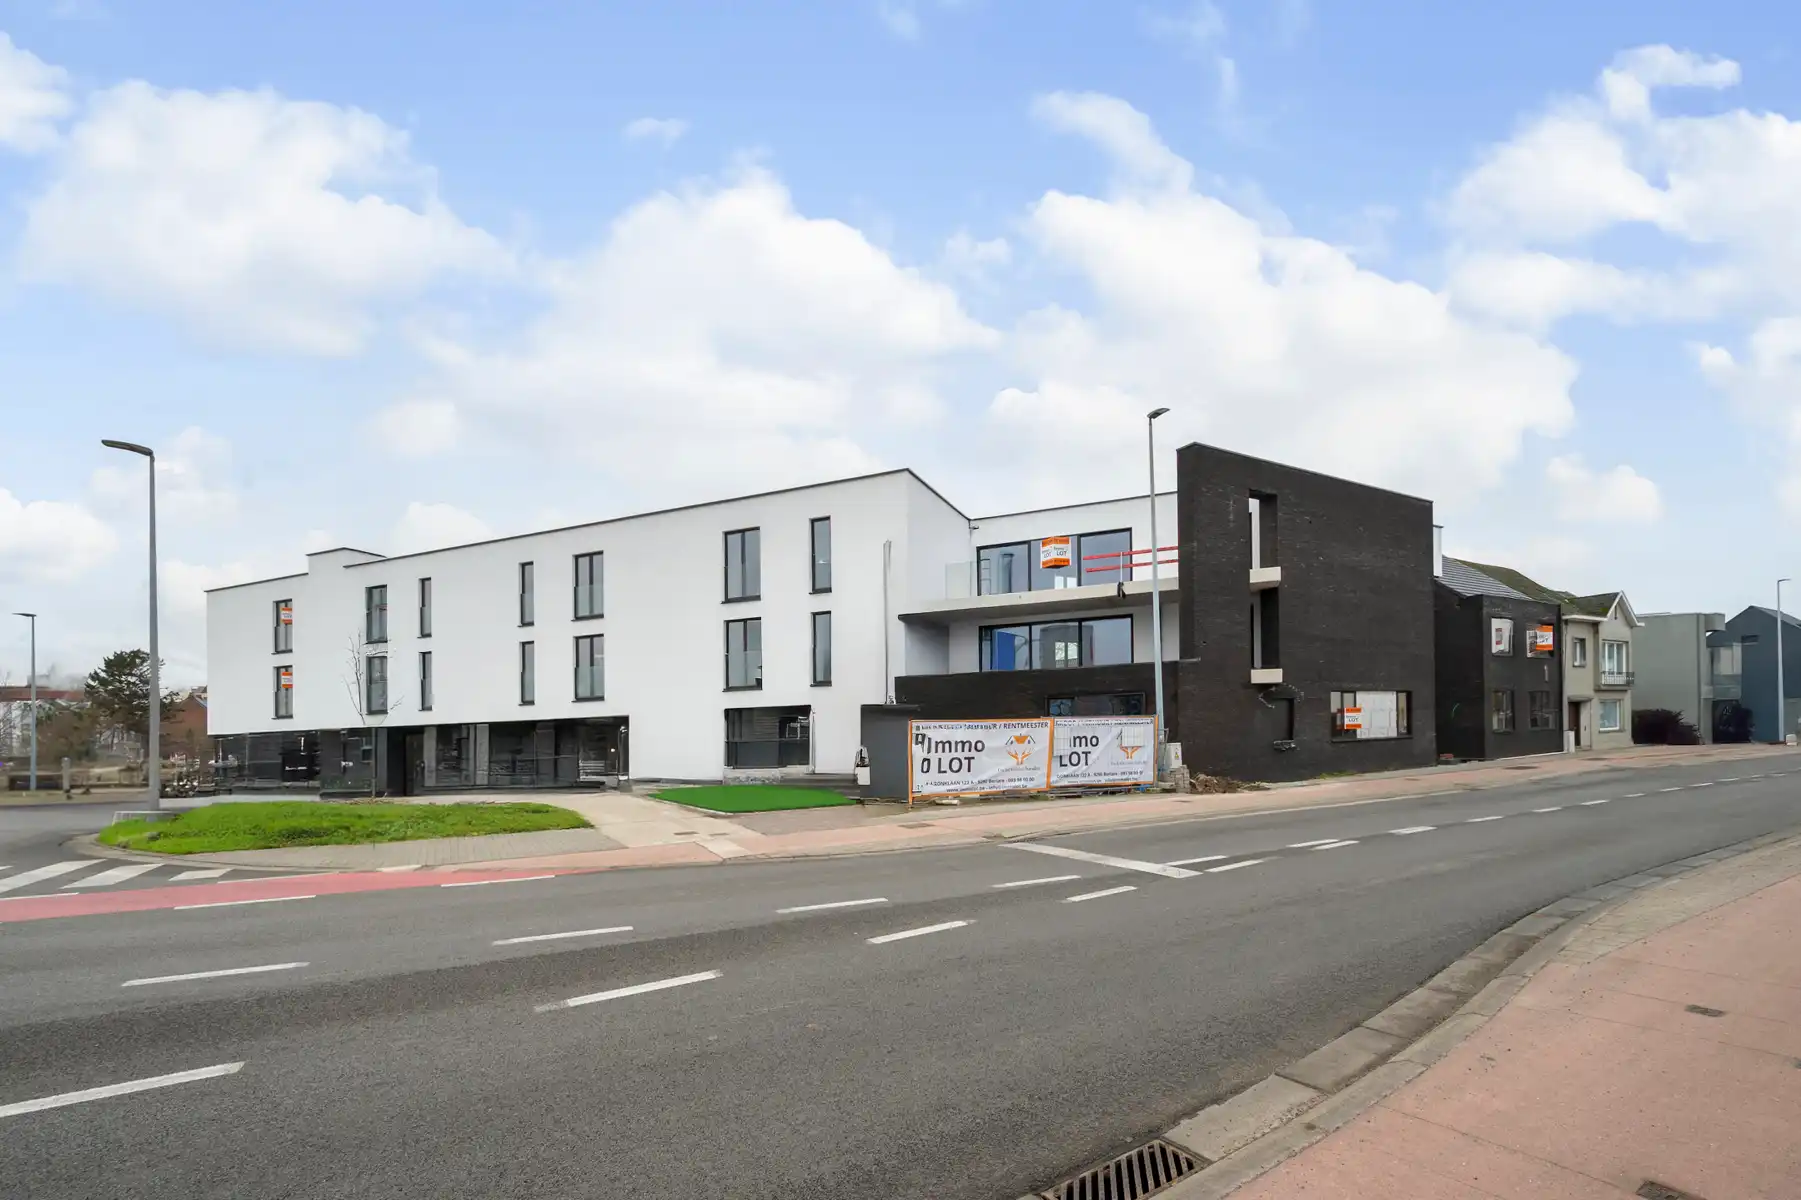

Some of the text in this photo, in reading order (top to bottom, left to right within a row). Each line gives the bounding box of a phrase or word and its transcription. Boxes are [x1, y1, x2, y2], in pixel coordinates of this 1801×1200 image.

[1003, 722, 1049, 730] RENTMEESTER
[927, 737, 986, 754] Immo
[937, 756, 976, 774] LOT
[1059, 751, 1092, 768] LOT
